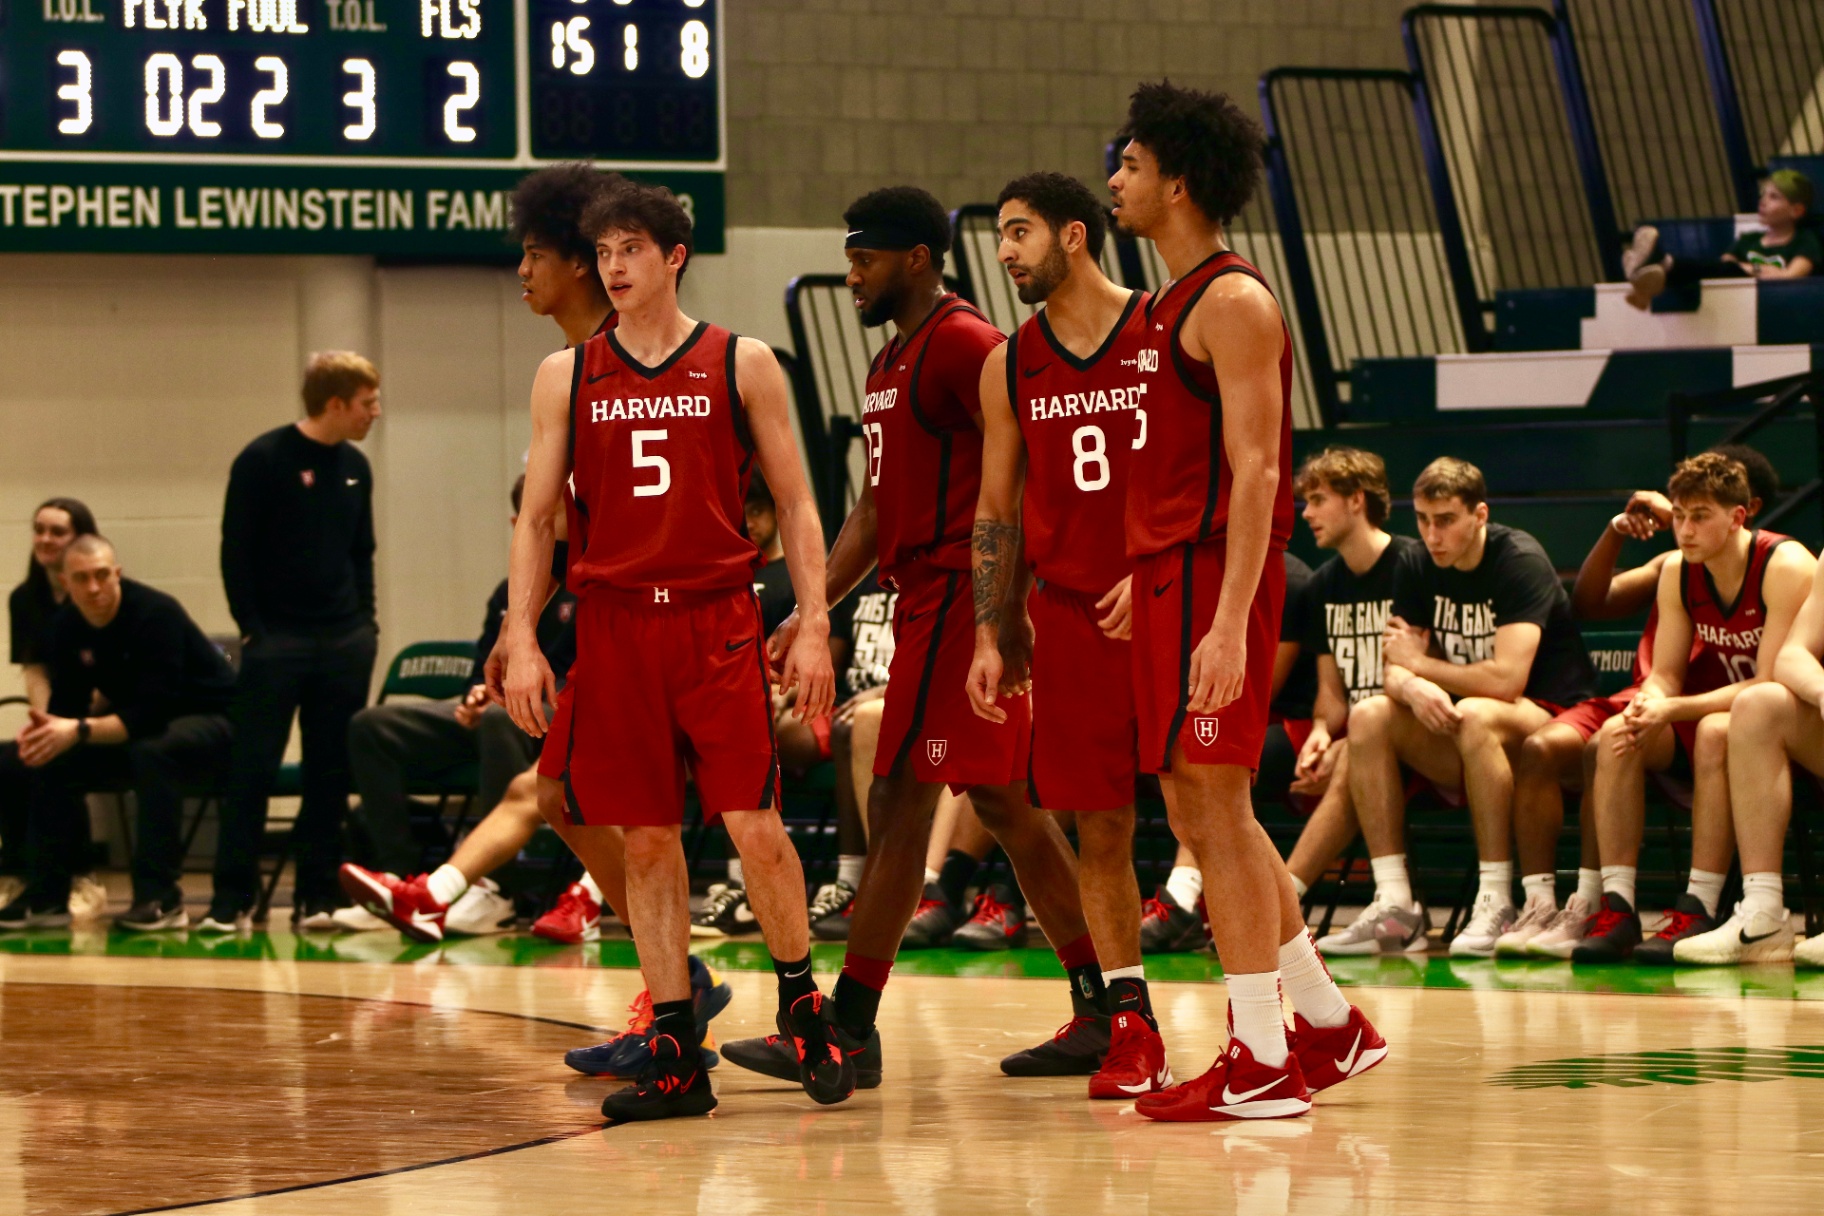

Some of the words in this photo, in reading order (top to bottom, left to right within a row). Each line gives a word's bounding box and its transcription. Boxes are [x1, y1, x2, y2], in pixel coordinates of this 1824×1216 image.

[326, 0, 388, 31] T.O.L.
[421, 0, 481, 38] FLS
[681, 20, 709, 78] 8
[57, 51, 92, 134] 3
[145, 53, 225, 137] 02
[251, 57, 288, 138] 2
[343, 59, 376, 140] 3
[444, 62, 480, 142] 2
[175, 188, 414, 230] LEWINSTEIN
[591, 396, 711, 423] HARVARD
[1030, 387, 1141, 421] HARVARD
[631, 429, 671, 497] 5
[1072, 425, 1110, 492] 8
[653, 586, 670, 603] H
[1200, 721, 1213, 737] H
[932, 743, 943, 757] H
